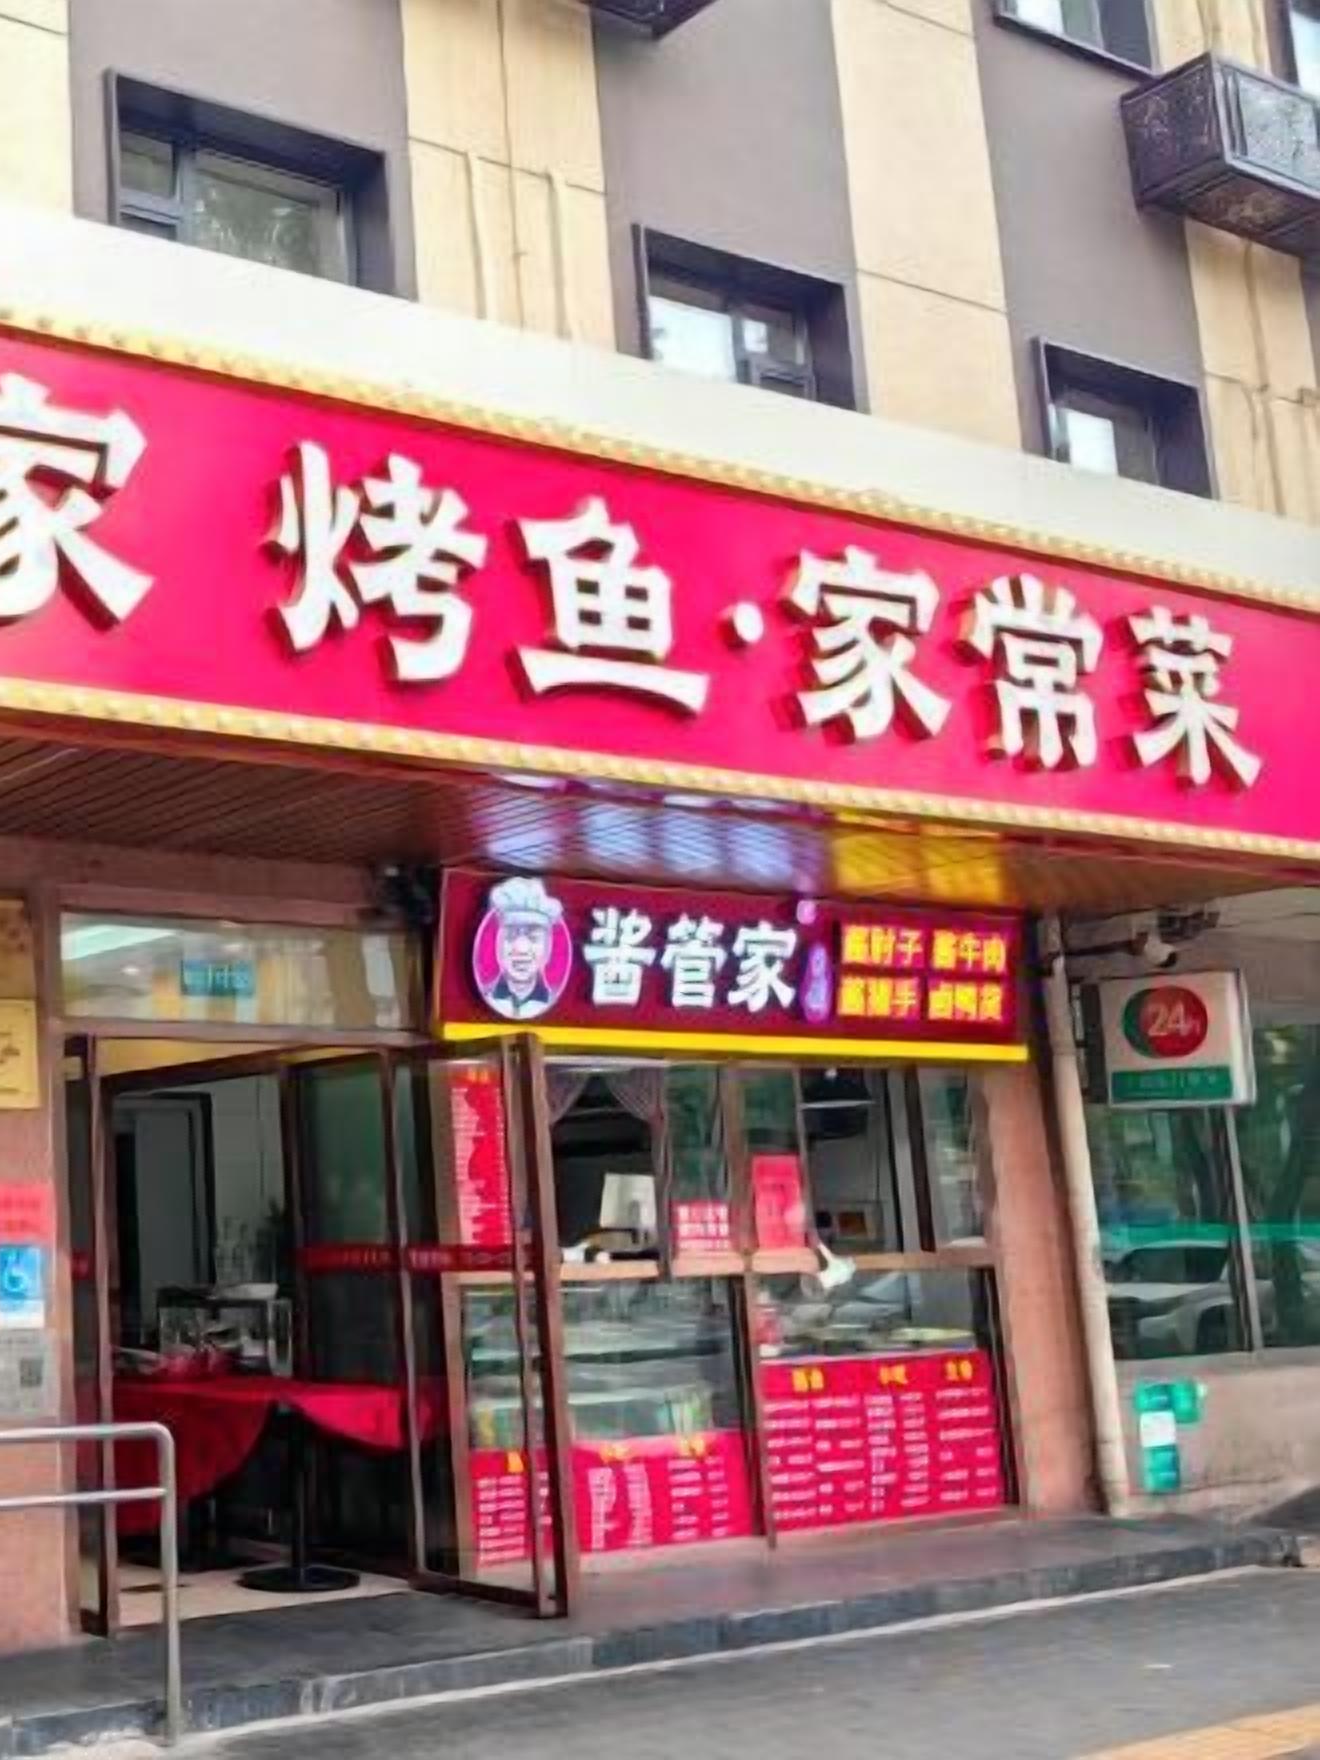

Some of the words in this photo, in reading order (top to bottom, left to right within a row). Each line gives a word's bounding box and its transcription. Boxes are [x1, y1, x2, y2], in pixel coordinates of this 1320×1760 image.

[262, 440, 1264, 788] 烤鱼·家常菜
[583, 905, 797, 1012] 酱管家
